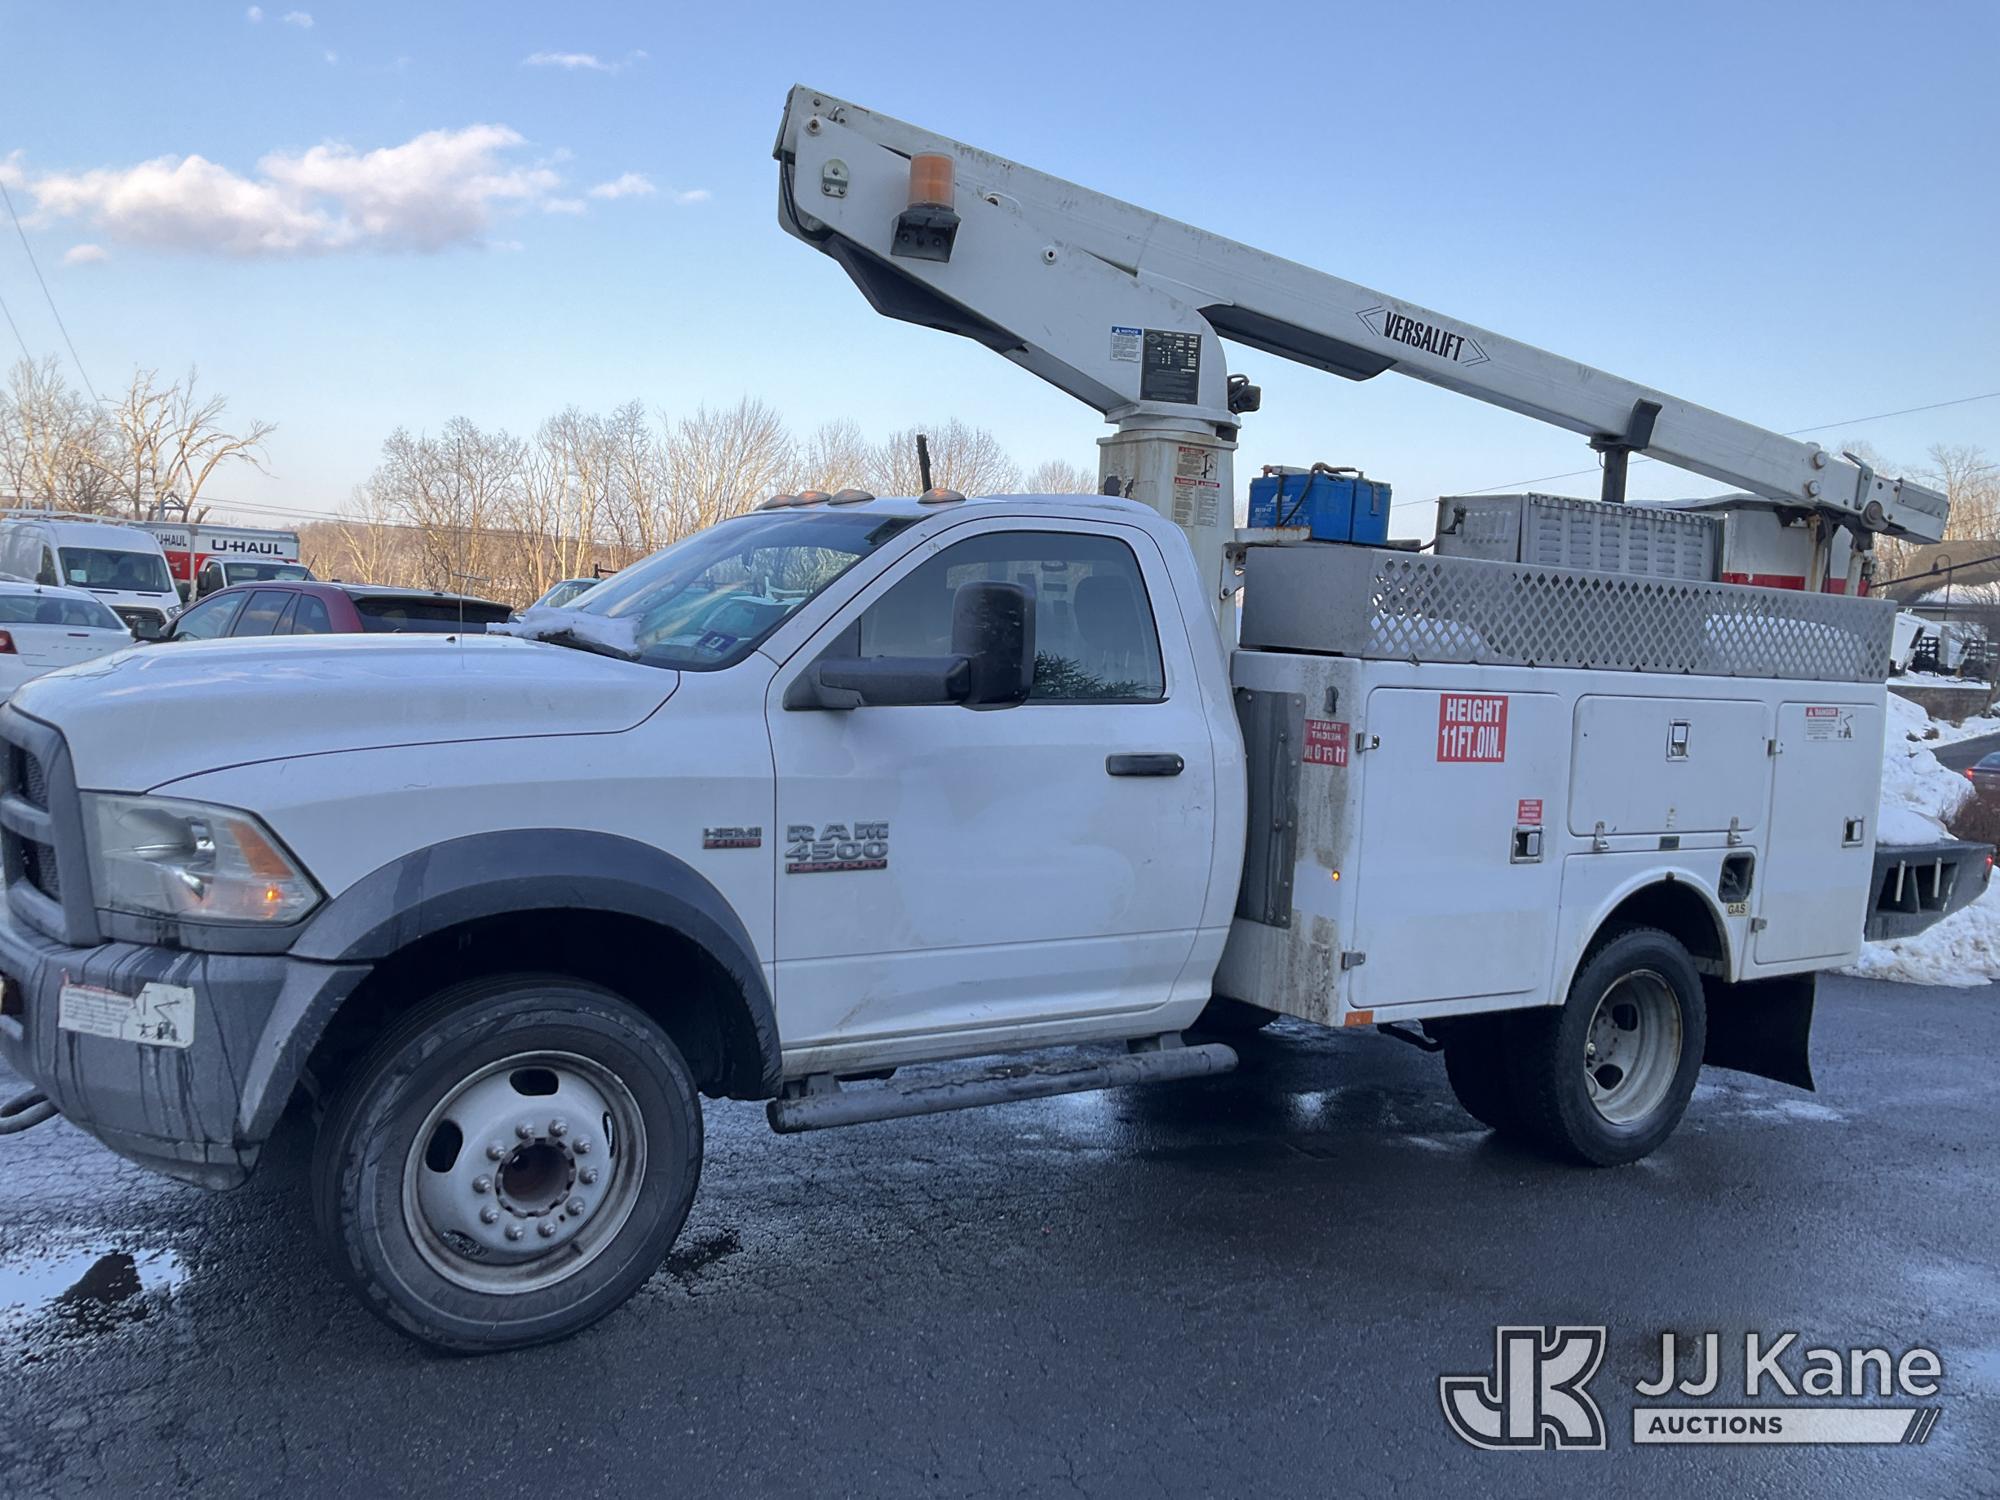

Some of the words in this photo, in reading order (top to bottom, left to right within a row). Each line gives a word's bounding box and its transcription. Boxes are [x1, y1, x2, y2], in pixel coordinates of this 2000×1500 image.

[1384, 311, 1465, 361] VERSALIFT
[211, 539, 284, 555] U-HAUL
[1446, 698, 1503, 722] HEIGHT
[703, 827, 762, 838] HEMI
[787, 821, 889, 842] RAM
[785, 841, 888, 861] 4500
[1728, 904, 1746, 914] GAS
